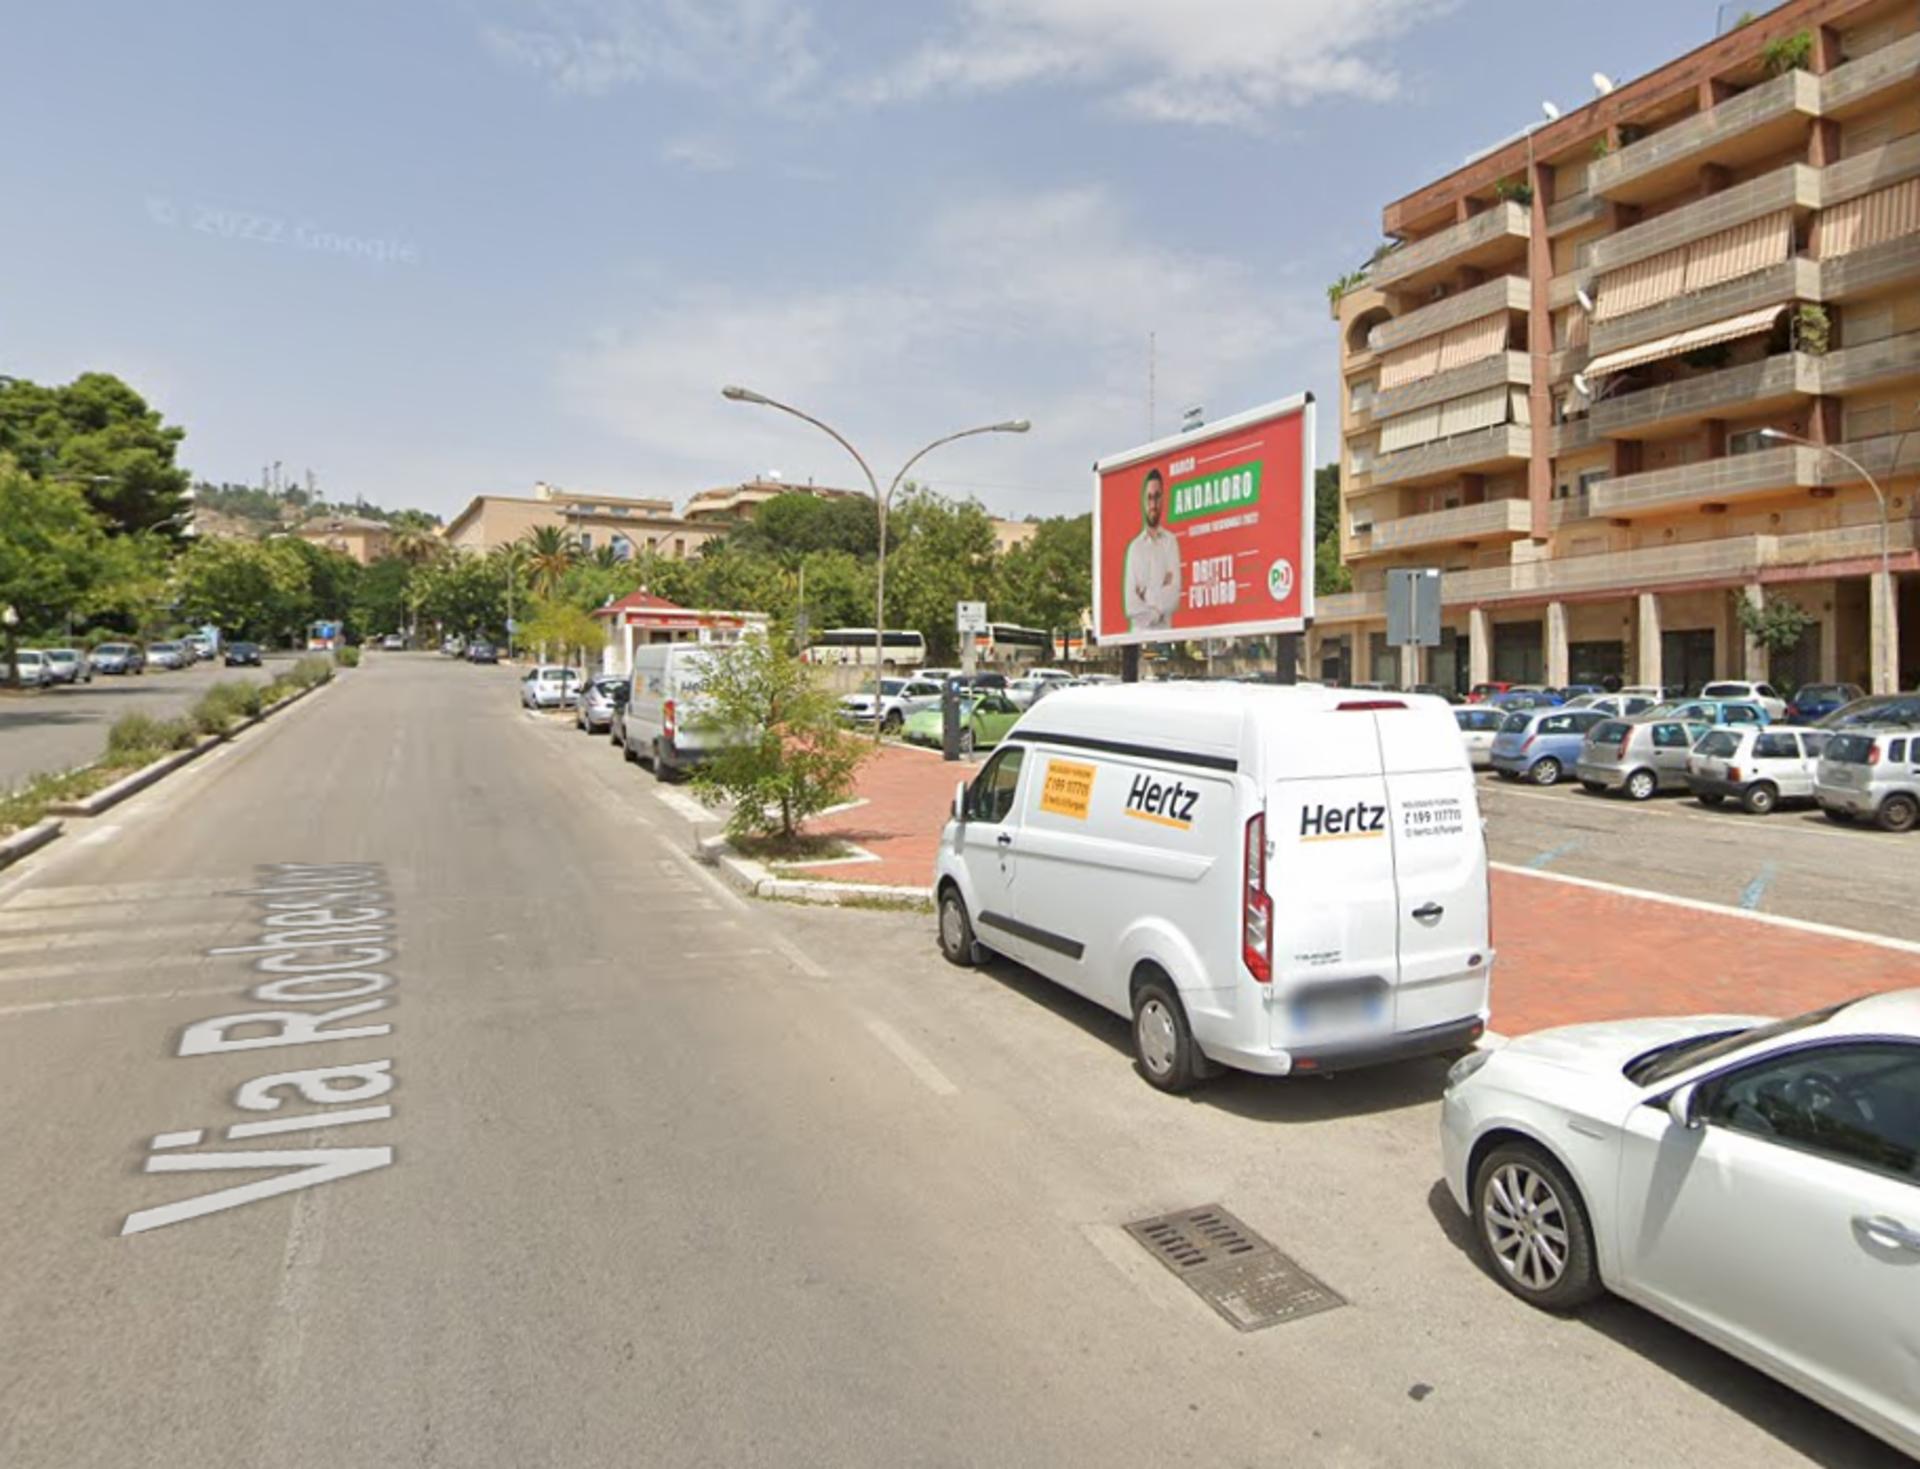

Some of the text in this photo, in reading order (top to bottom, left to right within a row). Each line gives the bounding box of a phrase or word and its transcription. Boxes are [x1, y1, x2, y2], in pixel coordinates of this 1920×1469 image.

[1175, 470, 1252, 515] ANDALORO
[1189, 579, 1236, 609] FUTURO
[1126, 773, 1200, 821] Hertz
[1300, 801, 1385, 836] Hertz
